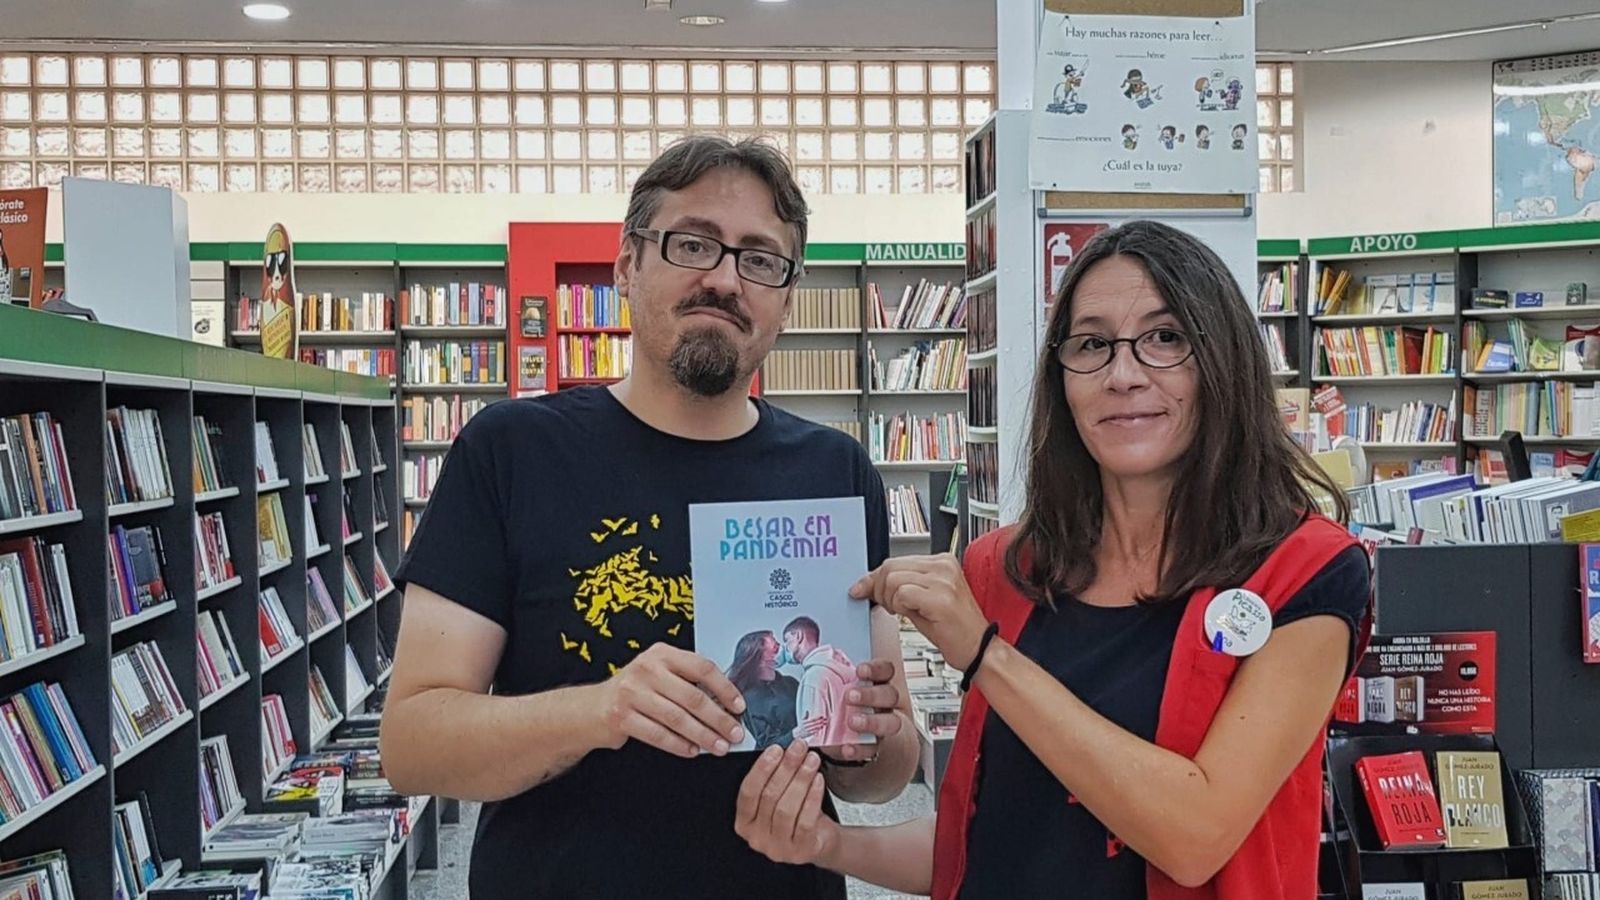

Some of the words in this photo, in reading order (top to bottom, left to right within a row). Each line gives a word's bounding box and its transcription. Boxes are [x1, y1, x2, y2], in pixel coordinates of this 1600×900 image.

[1065, 26, 1087, 39] Hay
[1090, 27, 1127, 38] muchas
[1130, 30, 1167, 39] razones
[1169, 31, 1190, 41] para
[1103, 160, 1131, 171] ¿Cuál
[1146, 160, 1154, 170] la
[1157, 163, 1182, 172] tuya?
[0, 211, 28, 223] lásico
[865, 244, 966, 260] MANUALID
[1350, 234, 1417, 253] APOYO
[725, 516, 796, 539] BESAR
[804, 515, 831, 535] EN
[720, 536, 837, 560] PANDEMIA
[764, 600, 799, 608] HISTÓRICO
[1232, 590, 1266, 621] Picasso
[1380, 654, 1400, 665] SERIE
[1402, 654, 1423, 665] REINA
[1424, 653, 1443, 664] ROJA
[1457, 775, 1485, 800] REY
[1391, 802, 1432, 826] ROJA
[1445, 803, 1501, 828] BLANCO
